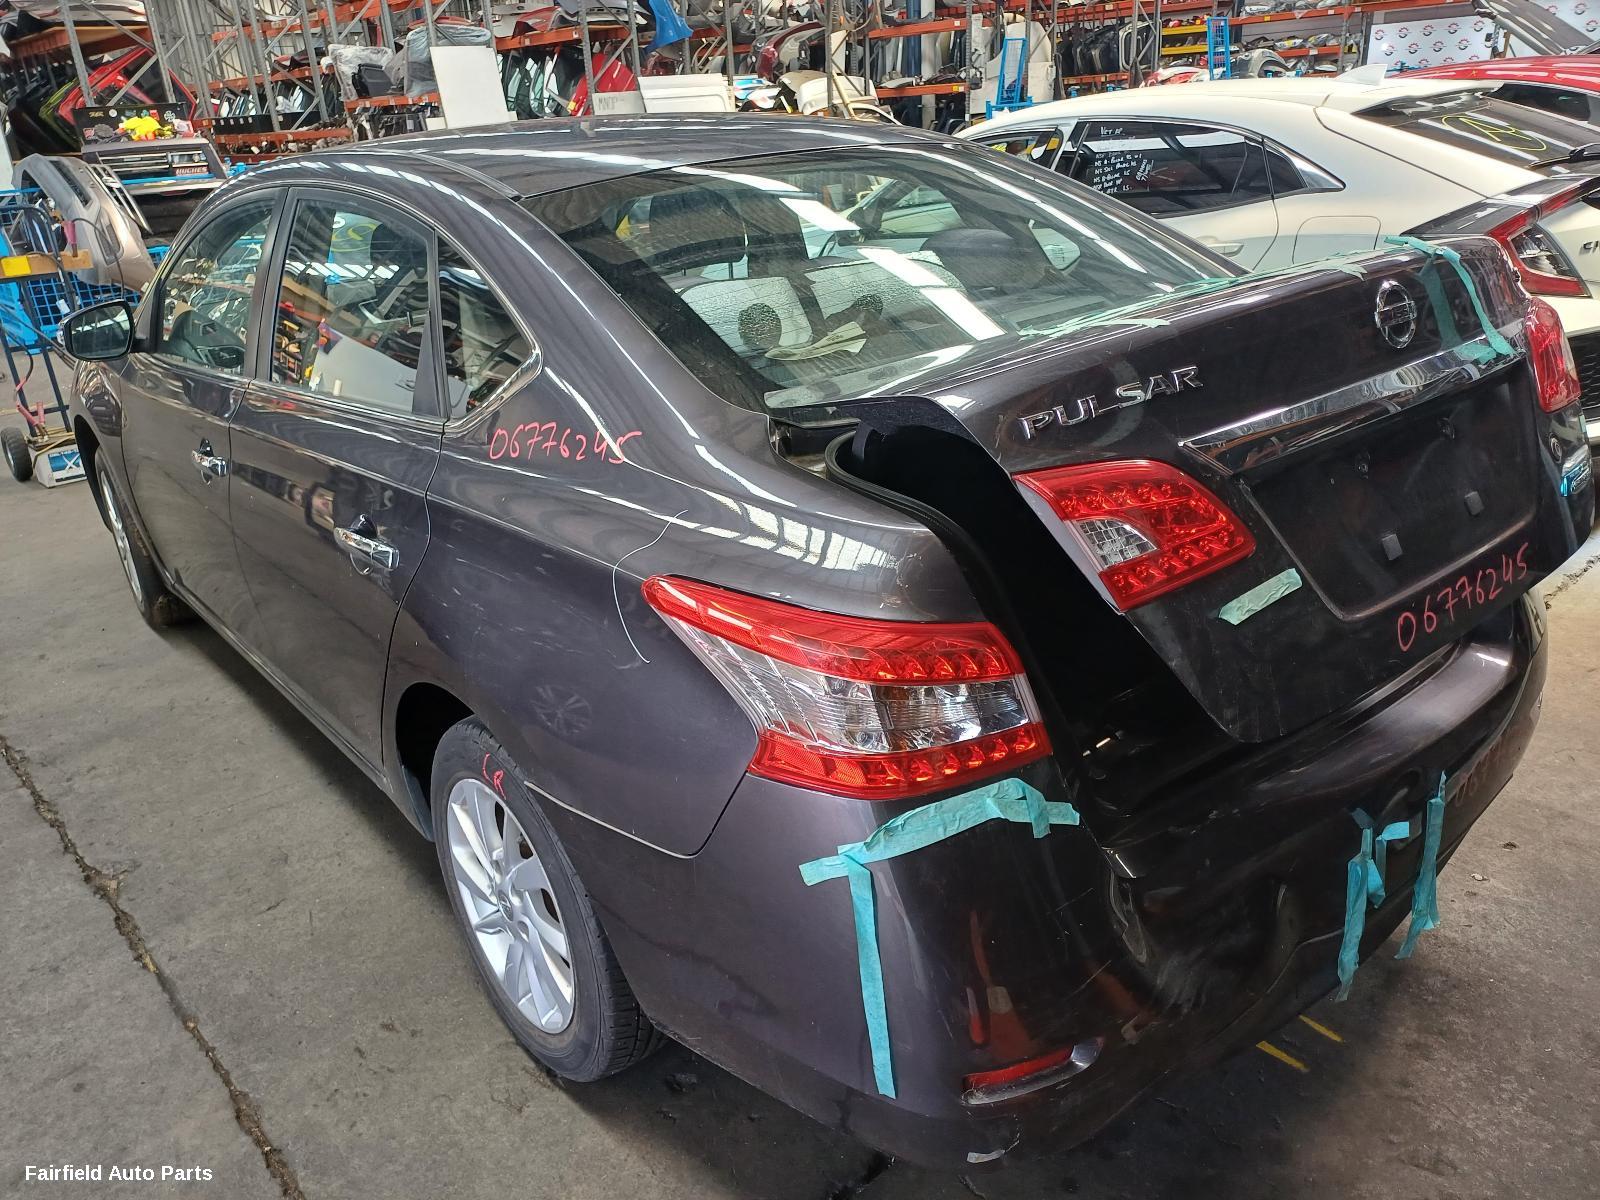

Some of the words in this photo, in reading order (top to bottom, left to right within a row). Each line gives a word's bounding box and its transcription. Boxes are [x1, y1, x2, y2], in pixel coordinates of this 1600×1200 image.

[1018, 365, 1204, 440] PULSAR
[489, 421, 643, 465] 06776245
[1397, 541, 1529, 653] 06776245
